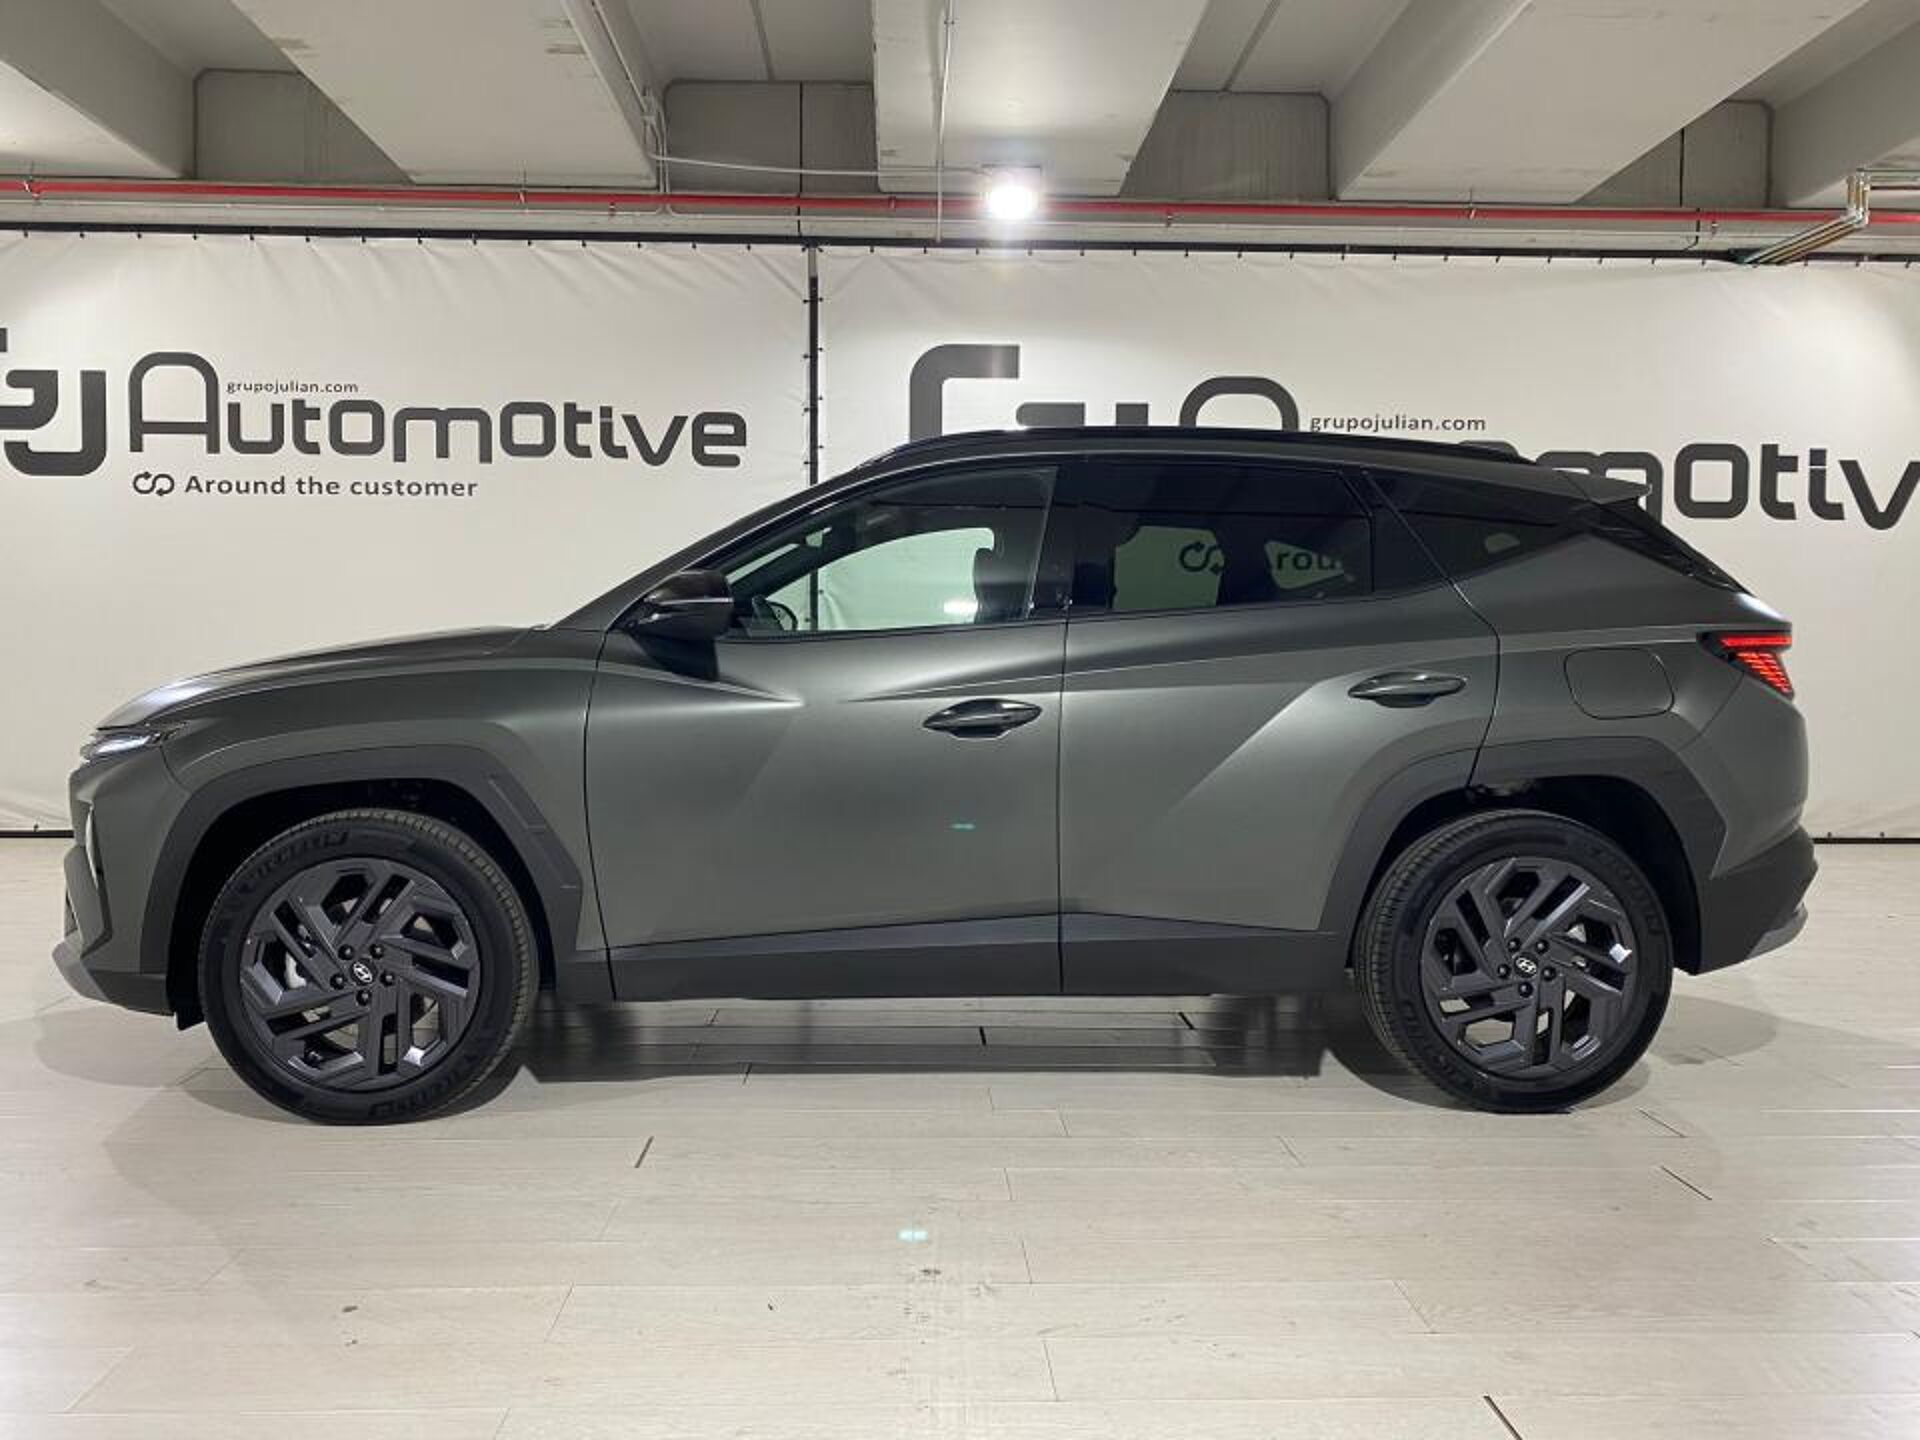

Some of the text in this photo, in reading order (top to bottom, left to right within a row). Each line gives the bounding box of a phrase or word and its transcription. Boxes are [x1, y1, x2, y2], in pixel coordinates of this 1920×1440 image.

[226, 381, 359, 395] grupojulian.com
[129, 352, 746, 467] Automotive
[1310, 414, 1486, 432] grupojulian.com
[185, 475, 478, 497] Around the customer
